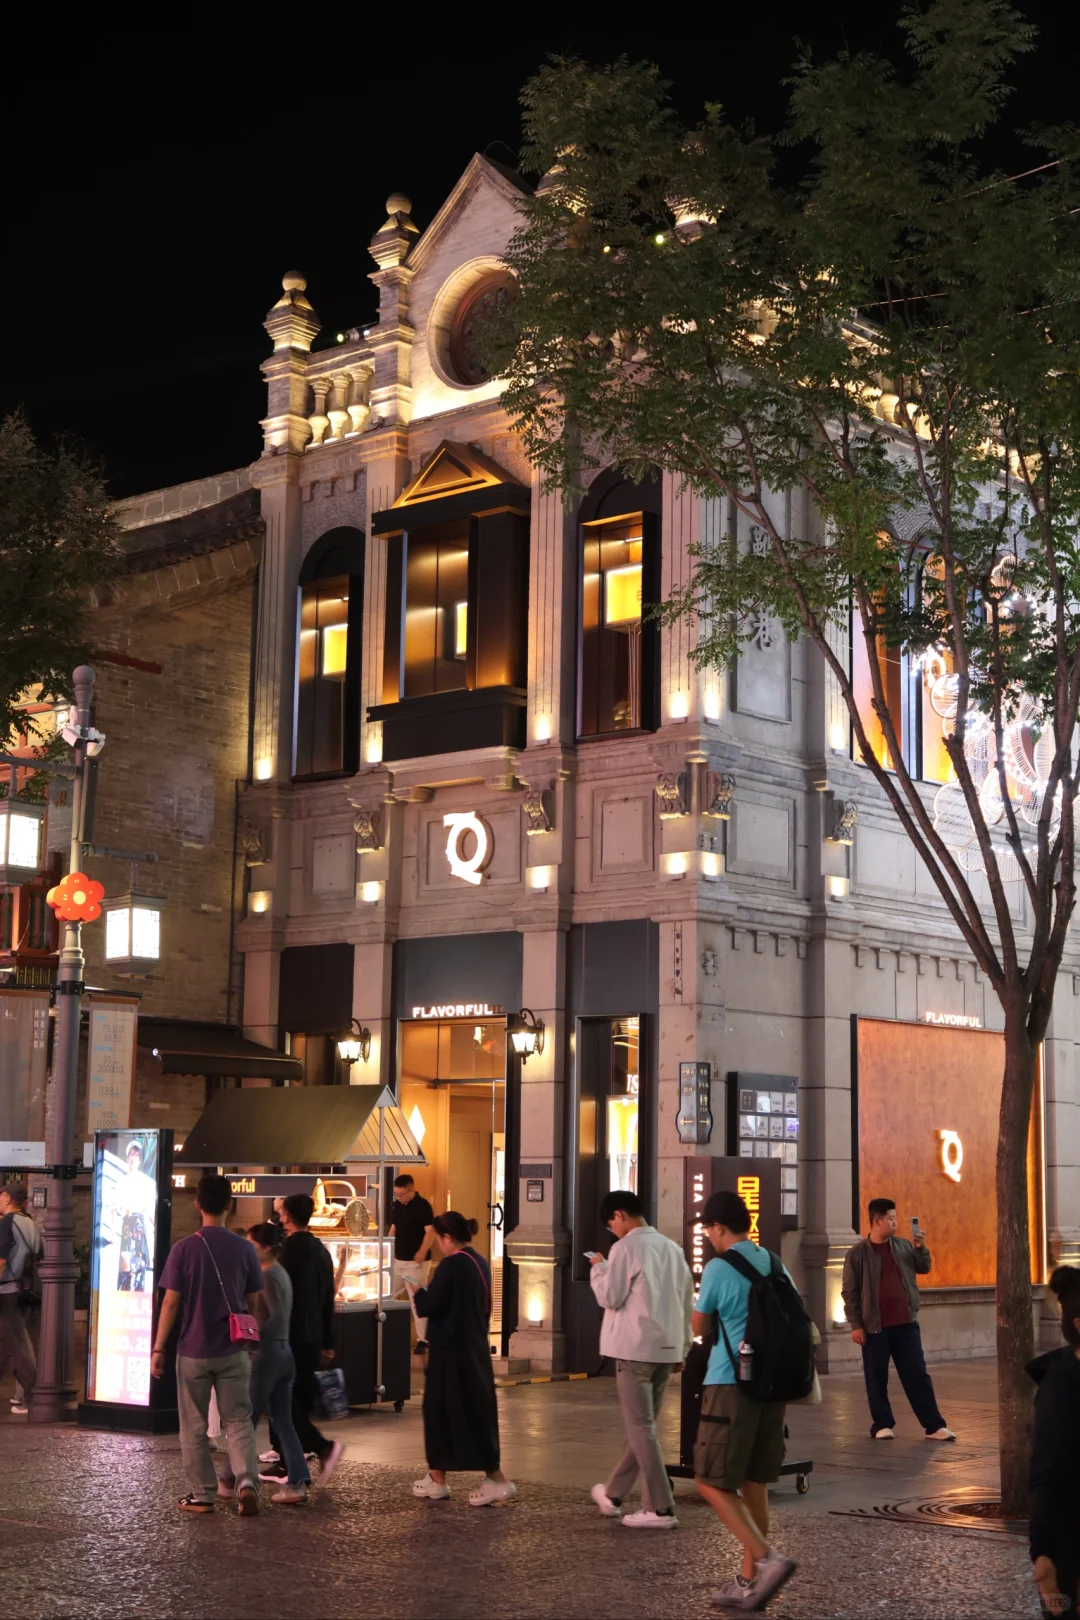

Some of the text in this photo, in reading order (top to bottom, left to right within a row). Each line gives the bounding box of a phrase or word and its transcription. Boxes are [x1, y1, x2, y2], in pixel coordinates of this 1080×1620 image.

[412, 1004, 493, 1018] FLAVORFUL
[926, 1011, 983, 1028] FLAVORFUL
[231, 1177, 256, 1194] orful
[693, 1173, 704, 1203] TEA
[692, 1223, 704, 1274] MUSIC
